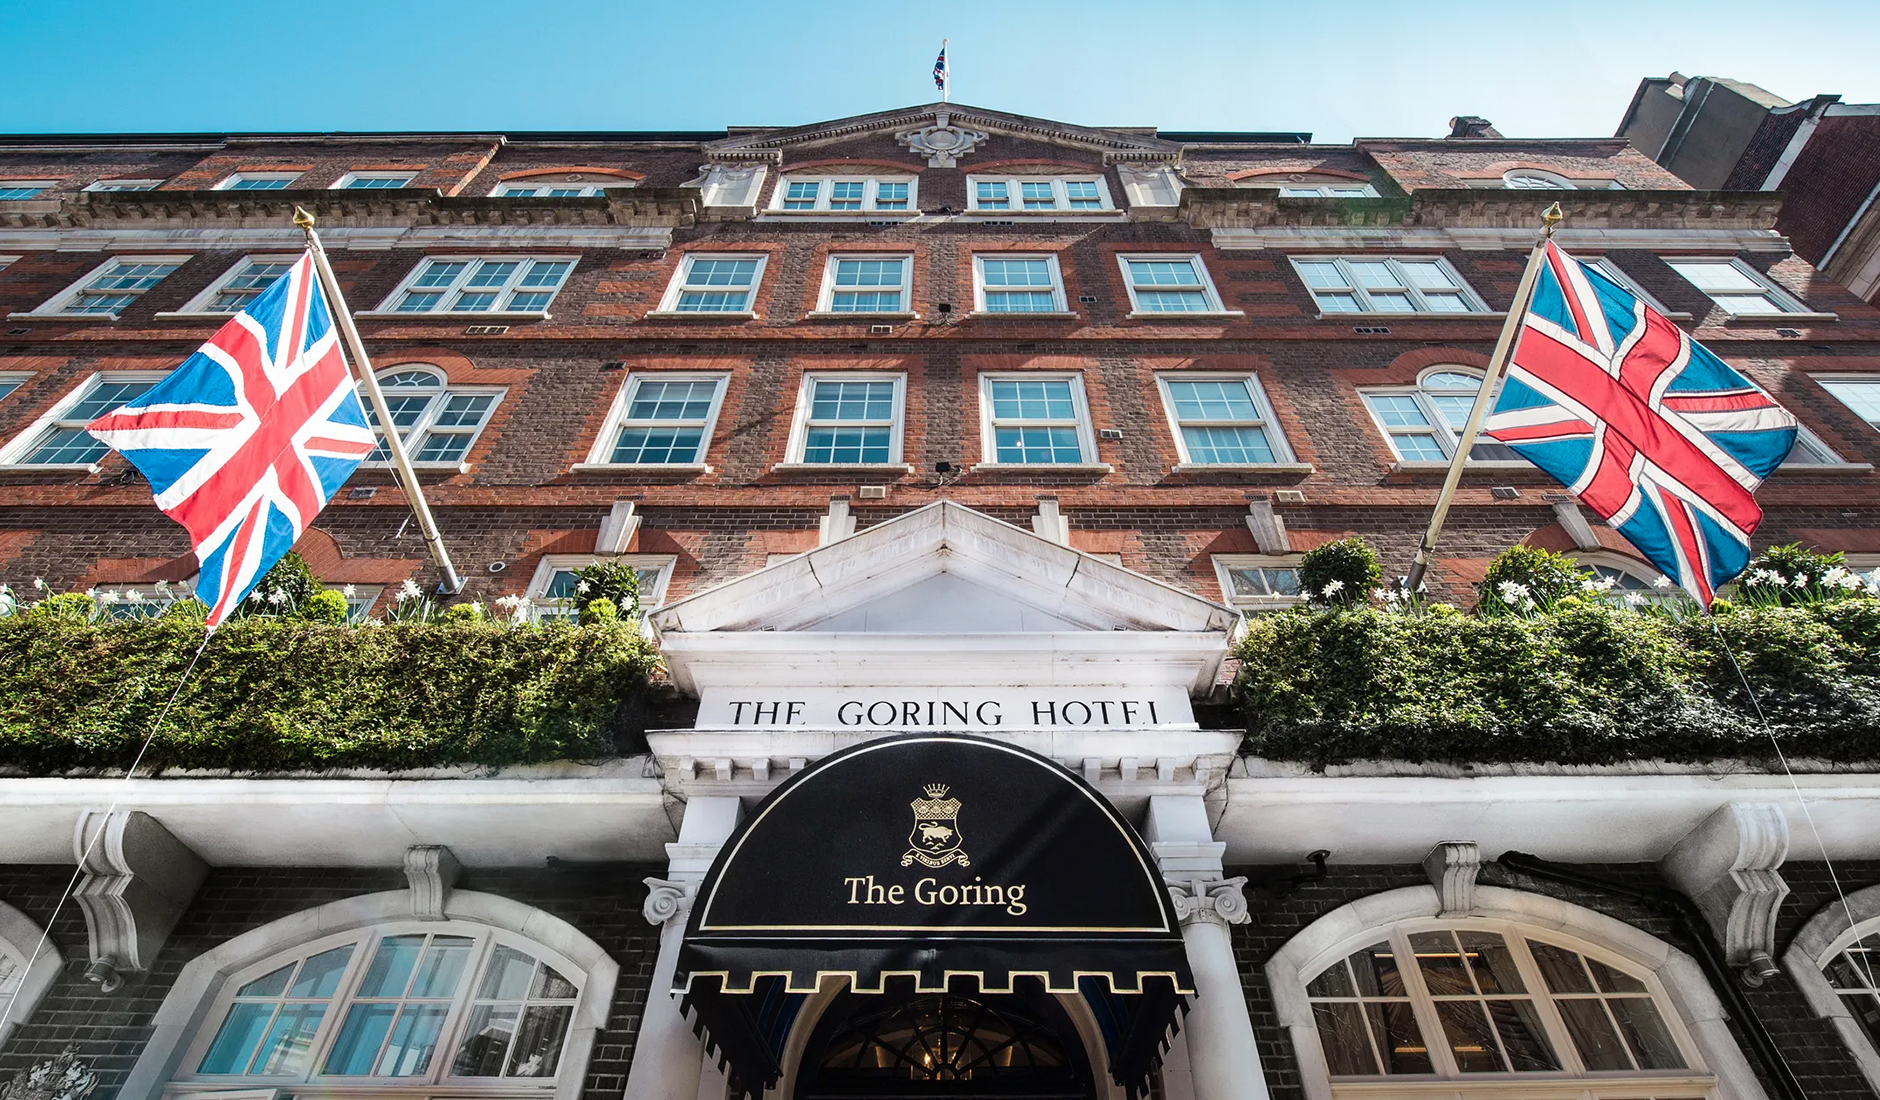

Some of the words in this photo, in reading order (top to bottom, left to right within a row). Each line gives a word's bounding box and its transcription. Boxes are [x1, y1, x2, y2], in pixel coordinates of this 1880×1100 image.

[729, 701, 806, 725] THE
[837, 700, 1003, 726] GORING
[844, 875, 905, 905] The
[914, 876, 1028, 916] Goring
